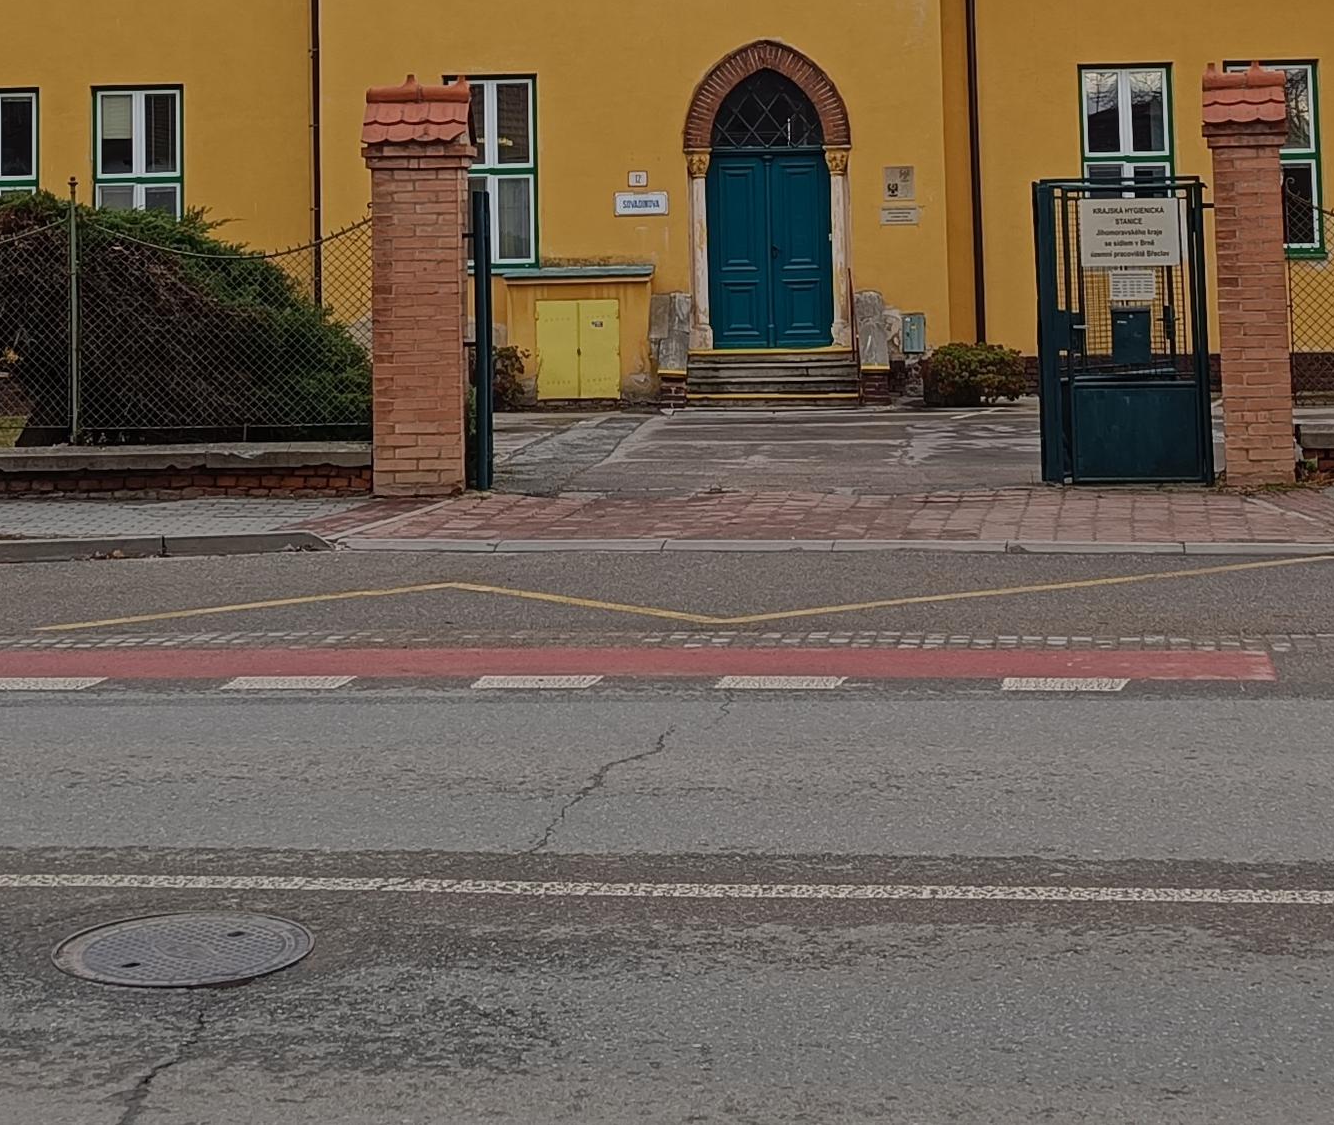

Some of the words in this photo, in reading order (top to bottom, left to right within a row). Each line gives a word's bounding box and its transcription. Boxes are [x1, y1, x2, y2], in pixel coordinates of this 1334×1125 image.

[1124, 206, 1164, 214] HYGIENICKÁ
[1147, 228, 1163, 237] kraje
[1113, 239, 1133, 247] sídlem
[1140, 239, 1155, 247] Brně
